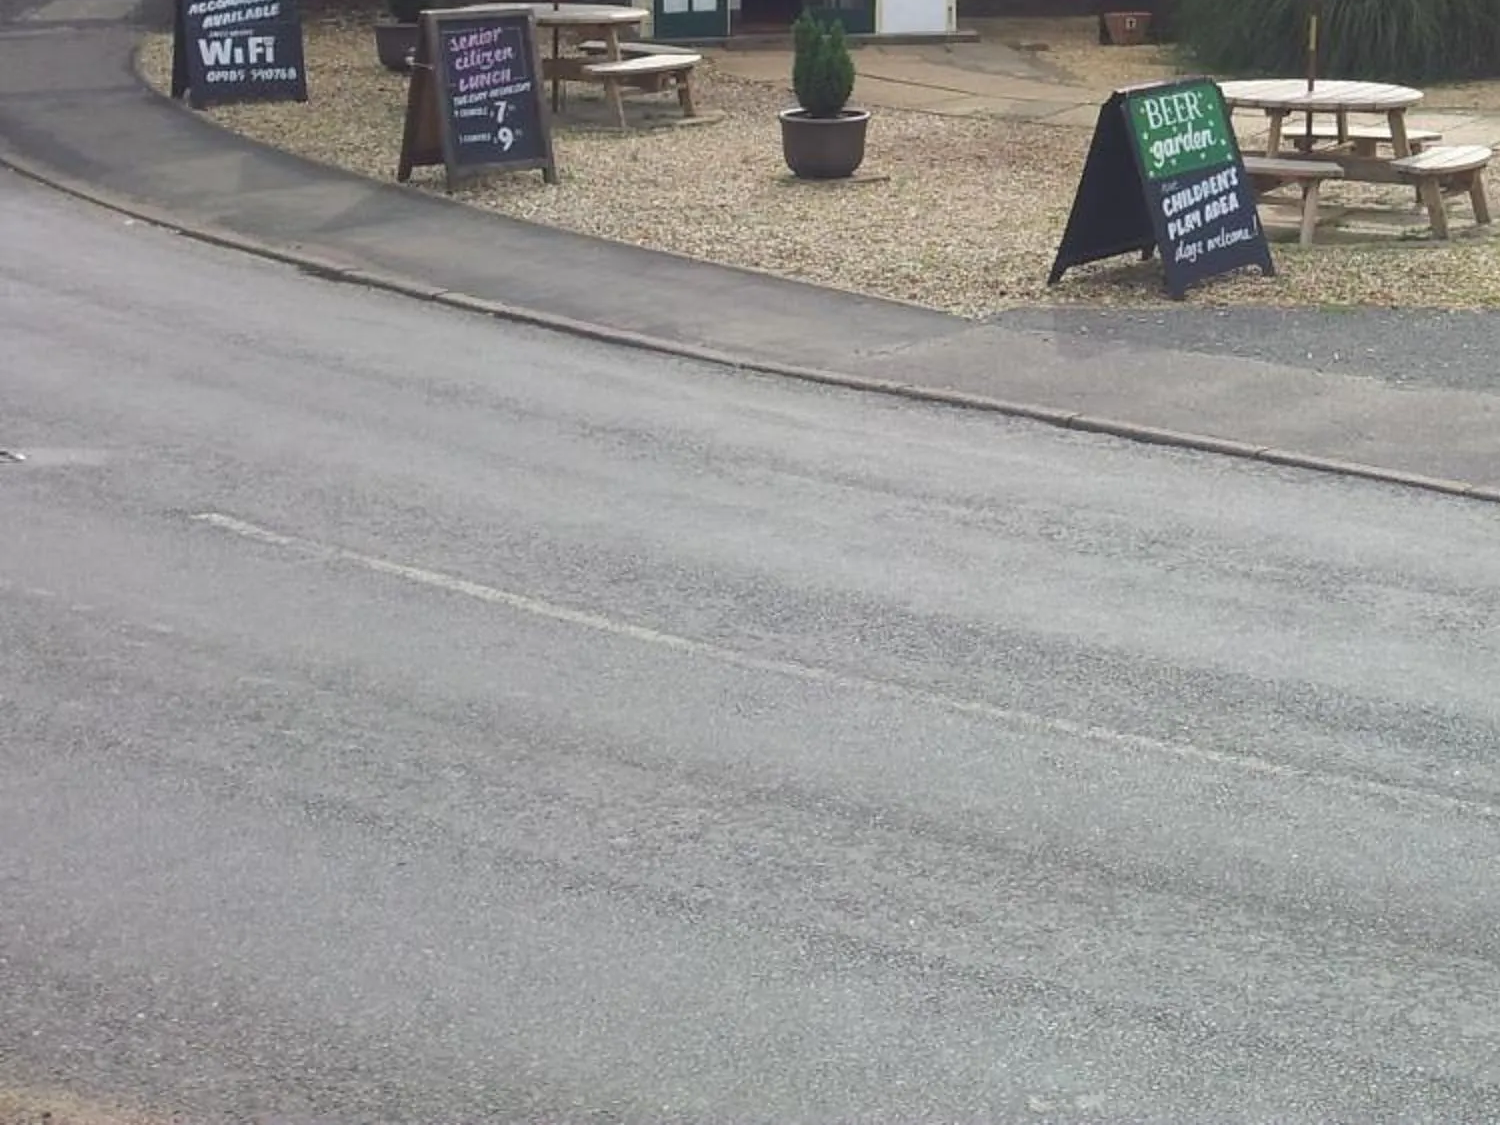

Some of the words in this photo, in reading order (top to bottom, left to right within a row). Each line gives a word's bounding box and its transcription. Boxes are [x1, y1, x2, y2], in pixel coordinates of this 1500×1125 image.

[202, 3, 280, 29] AVAILABLE
[459, 68, 511, 92] LUNCH
[1143, 90, 1203, 129] BEER
[1150, 122, 1217, 168] garden
[1167, 210, 1202, 241] PLAY
[1205, 192, 1239, 223] AREA
[1175, 240, 1204, 263] dogs
